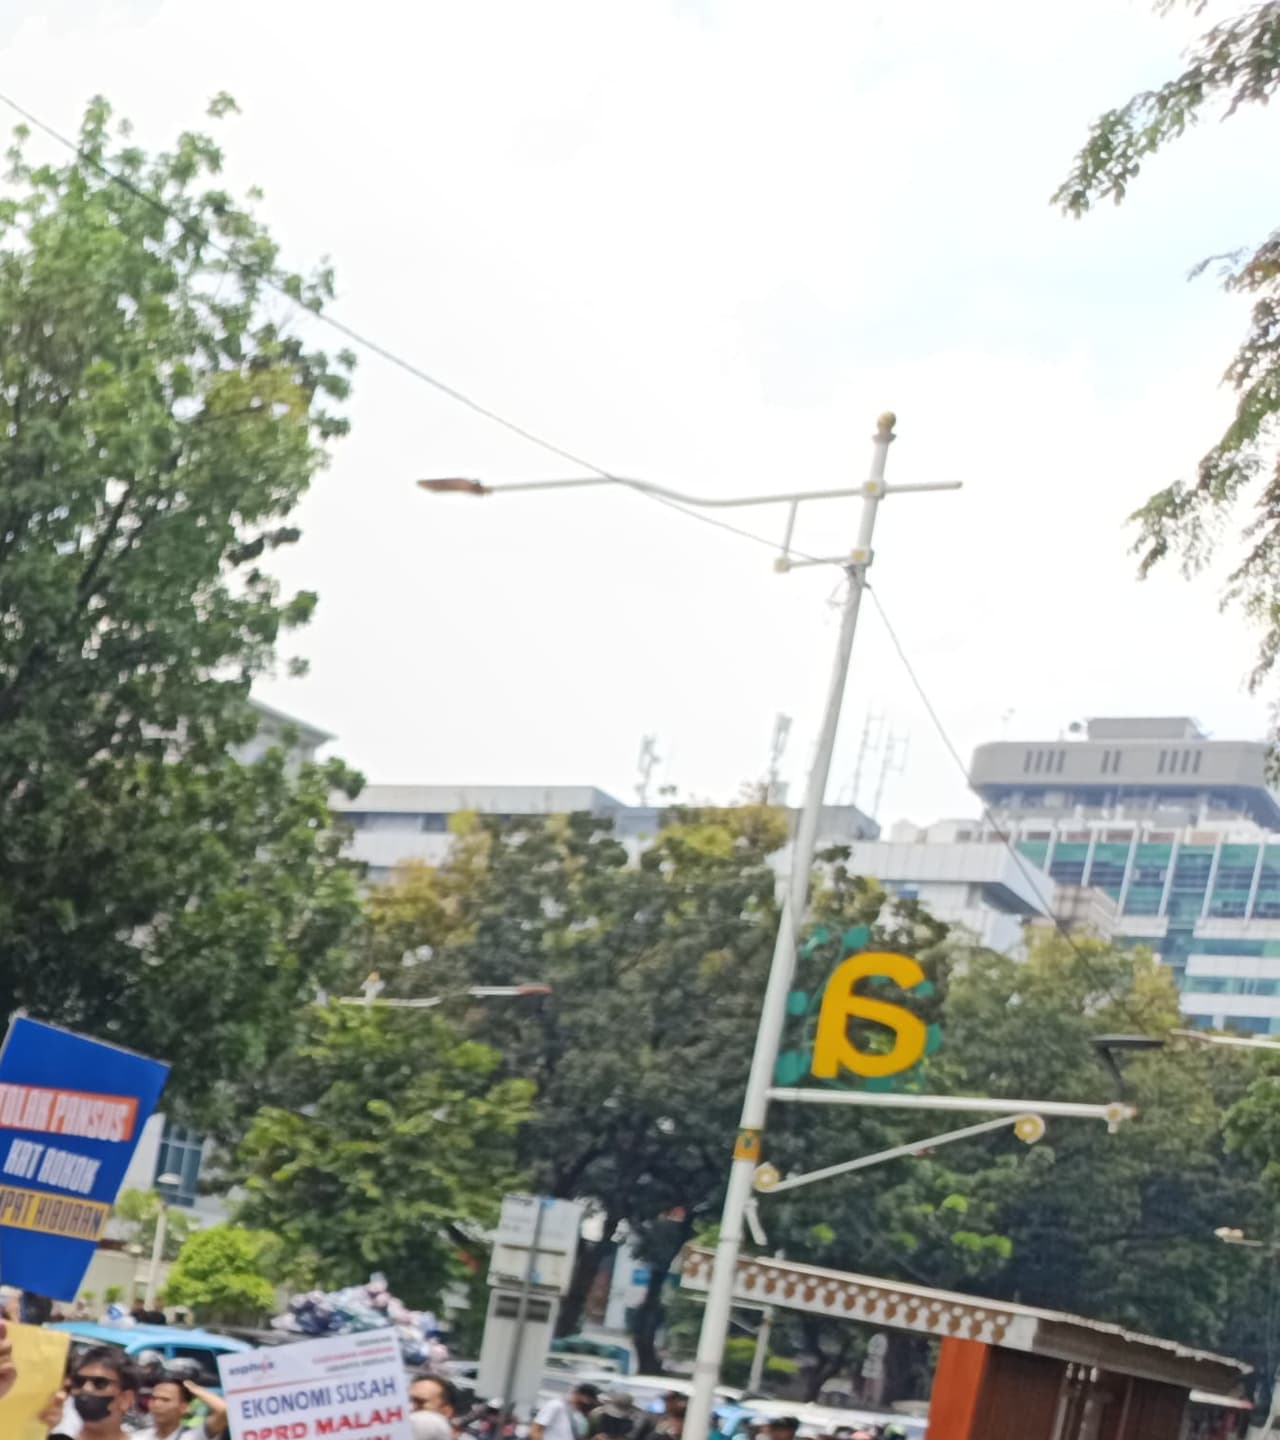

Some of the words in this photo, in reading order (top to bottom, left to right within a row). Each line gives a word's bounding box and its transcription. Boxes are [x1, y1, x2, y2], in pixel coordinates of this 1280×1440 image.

[50, 1093, 129, 1143] PANSUS
[36, 1197, 105, 1237] HIBURAN
[241, 1387, 331, 1420] EKONOMI
[336, 1377, 396, 1405] SUSAH
[315, 1406, 403, 1436] MALAH
